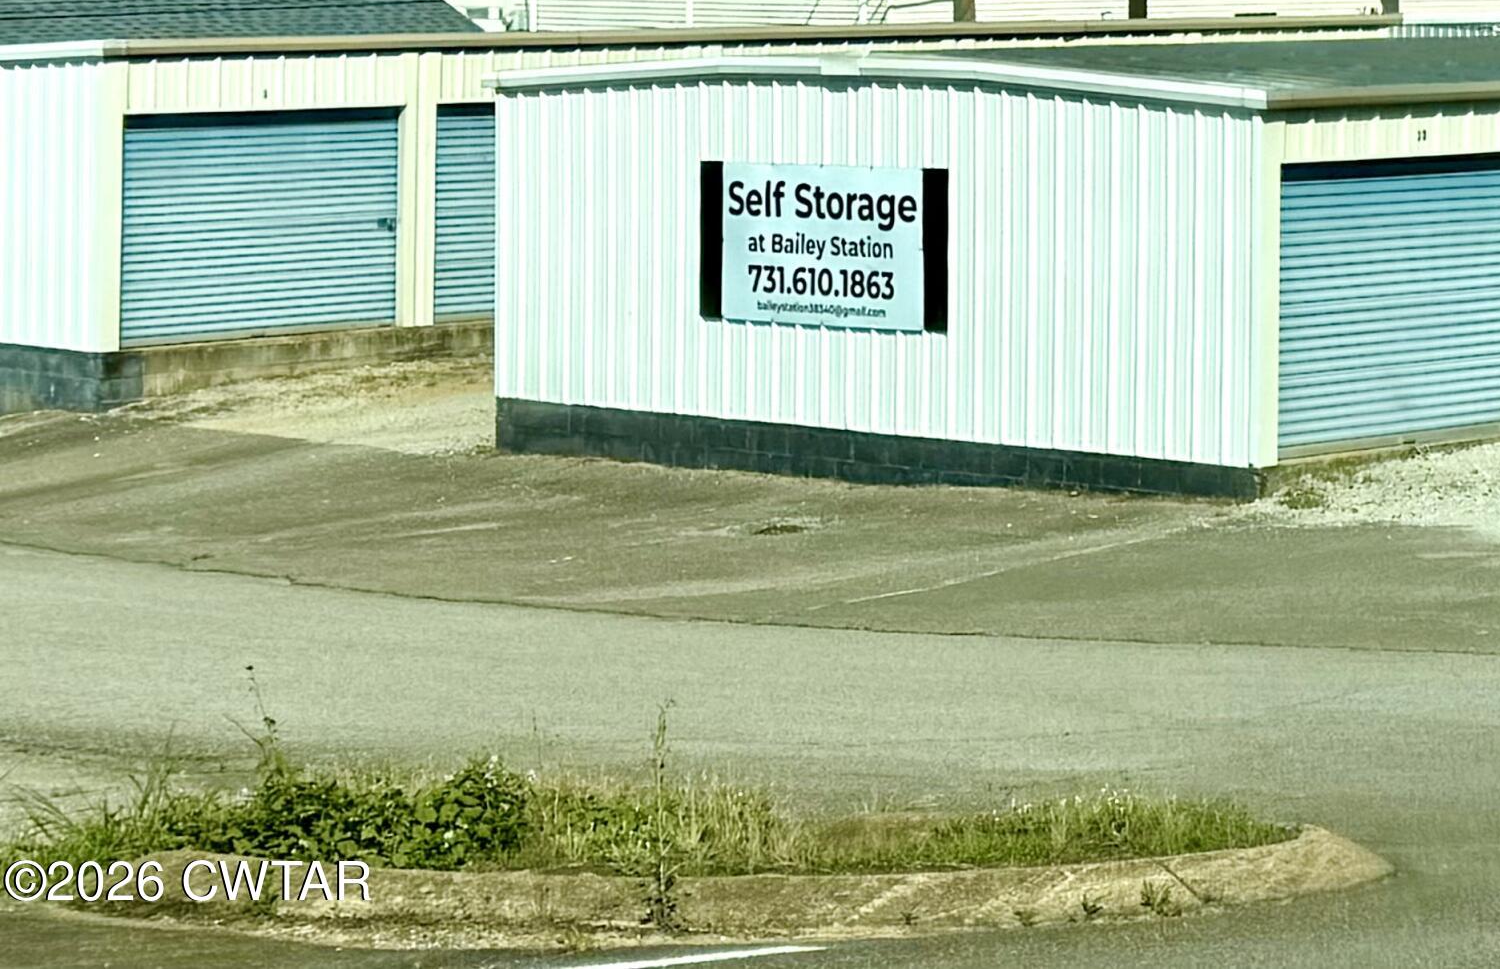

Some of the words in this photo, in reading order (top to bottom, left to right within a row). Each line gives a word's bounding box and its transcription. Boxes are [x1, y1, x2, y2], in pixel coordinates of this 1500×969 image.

[728, 180, 786, 218] Self
[794, 182, 918, 231] Storage
[748, 234, 766, 253] at
[771, 233, 827, 260] Bailey
[830, 235, 894, 259] Station
[748, 264, 895, 300] 731.610.1863
